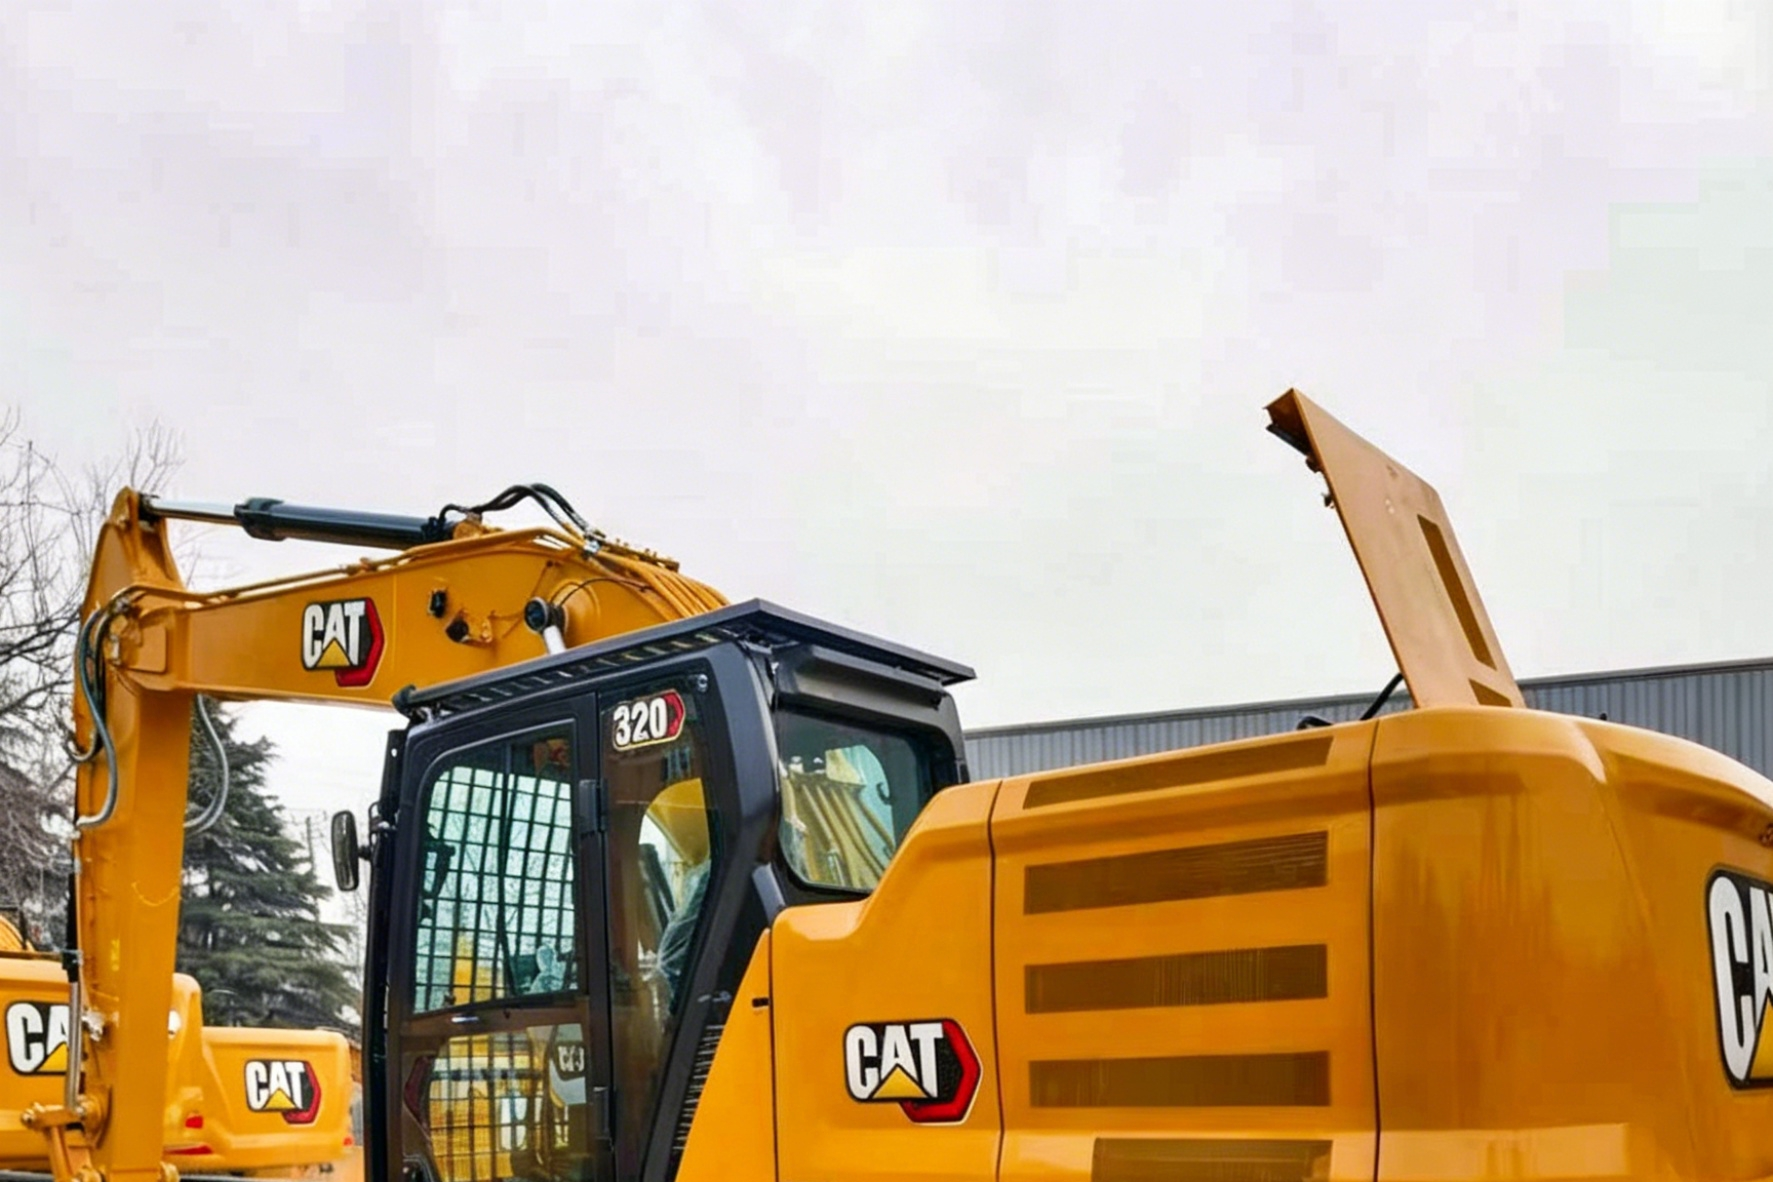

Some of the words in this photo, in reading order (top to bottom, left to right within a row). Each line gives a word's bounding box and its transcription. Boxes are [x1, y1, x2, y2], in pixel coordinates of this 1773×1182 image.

[303, 600, 366, 668] CAT
[613, 697, 667, 746] 320
[1709, 876, 1773, 1080] CA
[7, 1003, 70, 1073] CA
[845, 1022, 944, 1100] CAT
[245, 1061, 306, 1110] CAT
